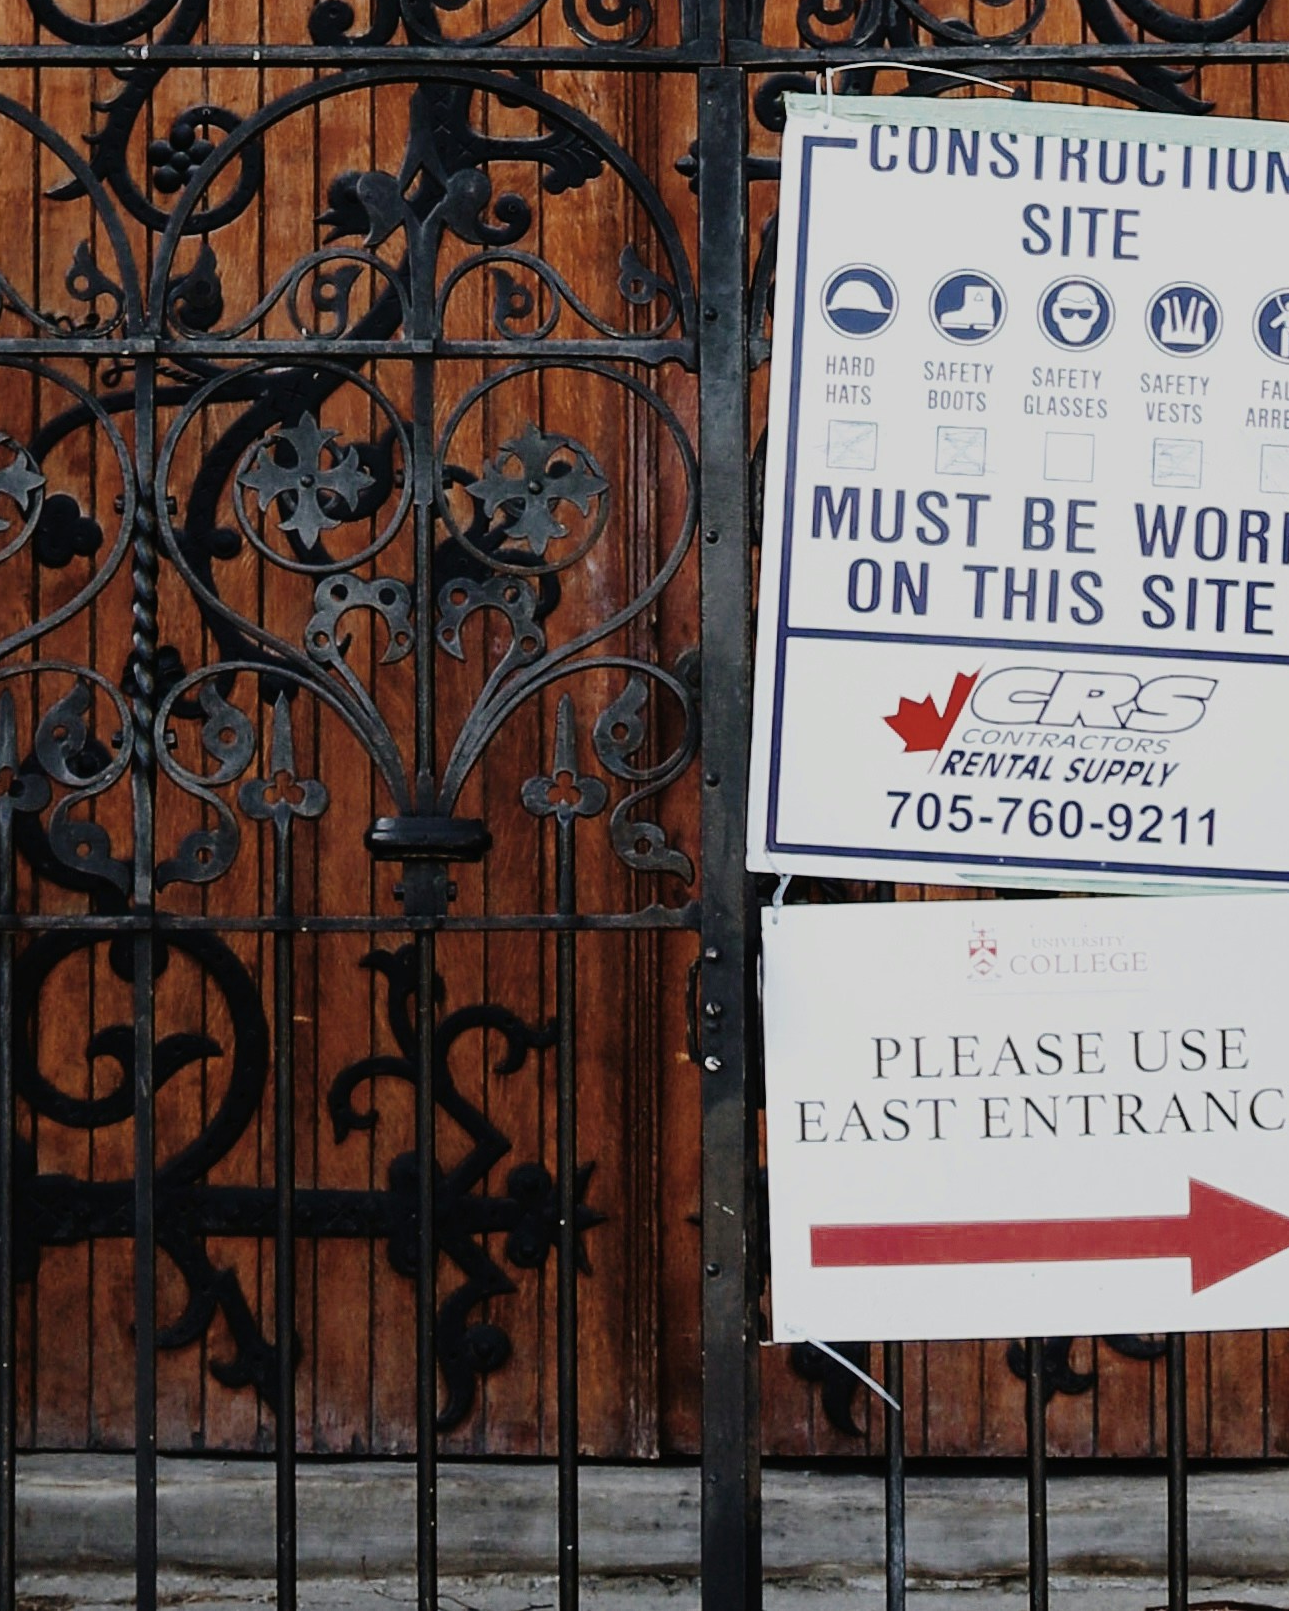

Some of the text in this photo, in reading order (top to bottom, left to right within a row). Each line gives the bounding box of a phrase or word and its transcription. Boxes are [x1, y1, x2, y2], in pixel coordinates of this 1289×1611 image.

[1022, 203, 1140, 260] SITE
[826, 356, 874, 377] HARD
[924, 361, 993, 383] SAFETY
[1032, 367, 1101, 389] SAFETY
[826, 384, 871, 405] HATS
[1140, 373, 1209, 395] SAFETY
[928, 389, 986, 412] BOOTS
[1024, 395, 1107, 418] GLASSES
[1146, 402, 1202, 424] VESTS
[812, 485, 991, 547] MUST
[1023, 497, 1097, 554] BE
[848, 558, 1275, 635] ON THIS SITE
[970, 665, 1219, 733] CRS
[960, 727, 1172, 755] CONTRACTORS
[940, 750, 1179, 787] RENTAL SUPPLY
[885, 790, 1216, 847] 705-760-9211
[1030, 934, 1125, 950] UNIVERSITY
[1009, 950, 1150, 976] COLLEGE
[873, 1028, 1248, 1078] PLEASE USE
[796, 1099, 956, 1142] EAST
